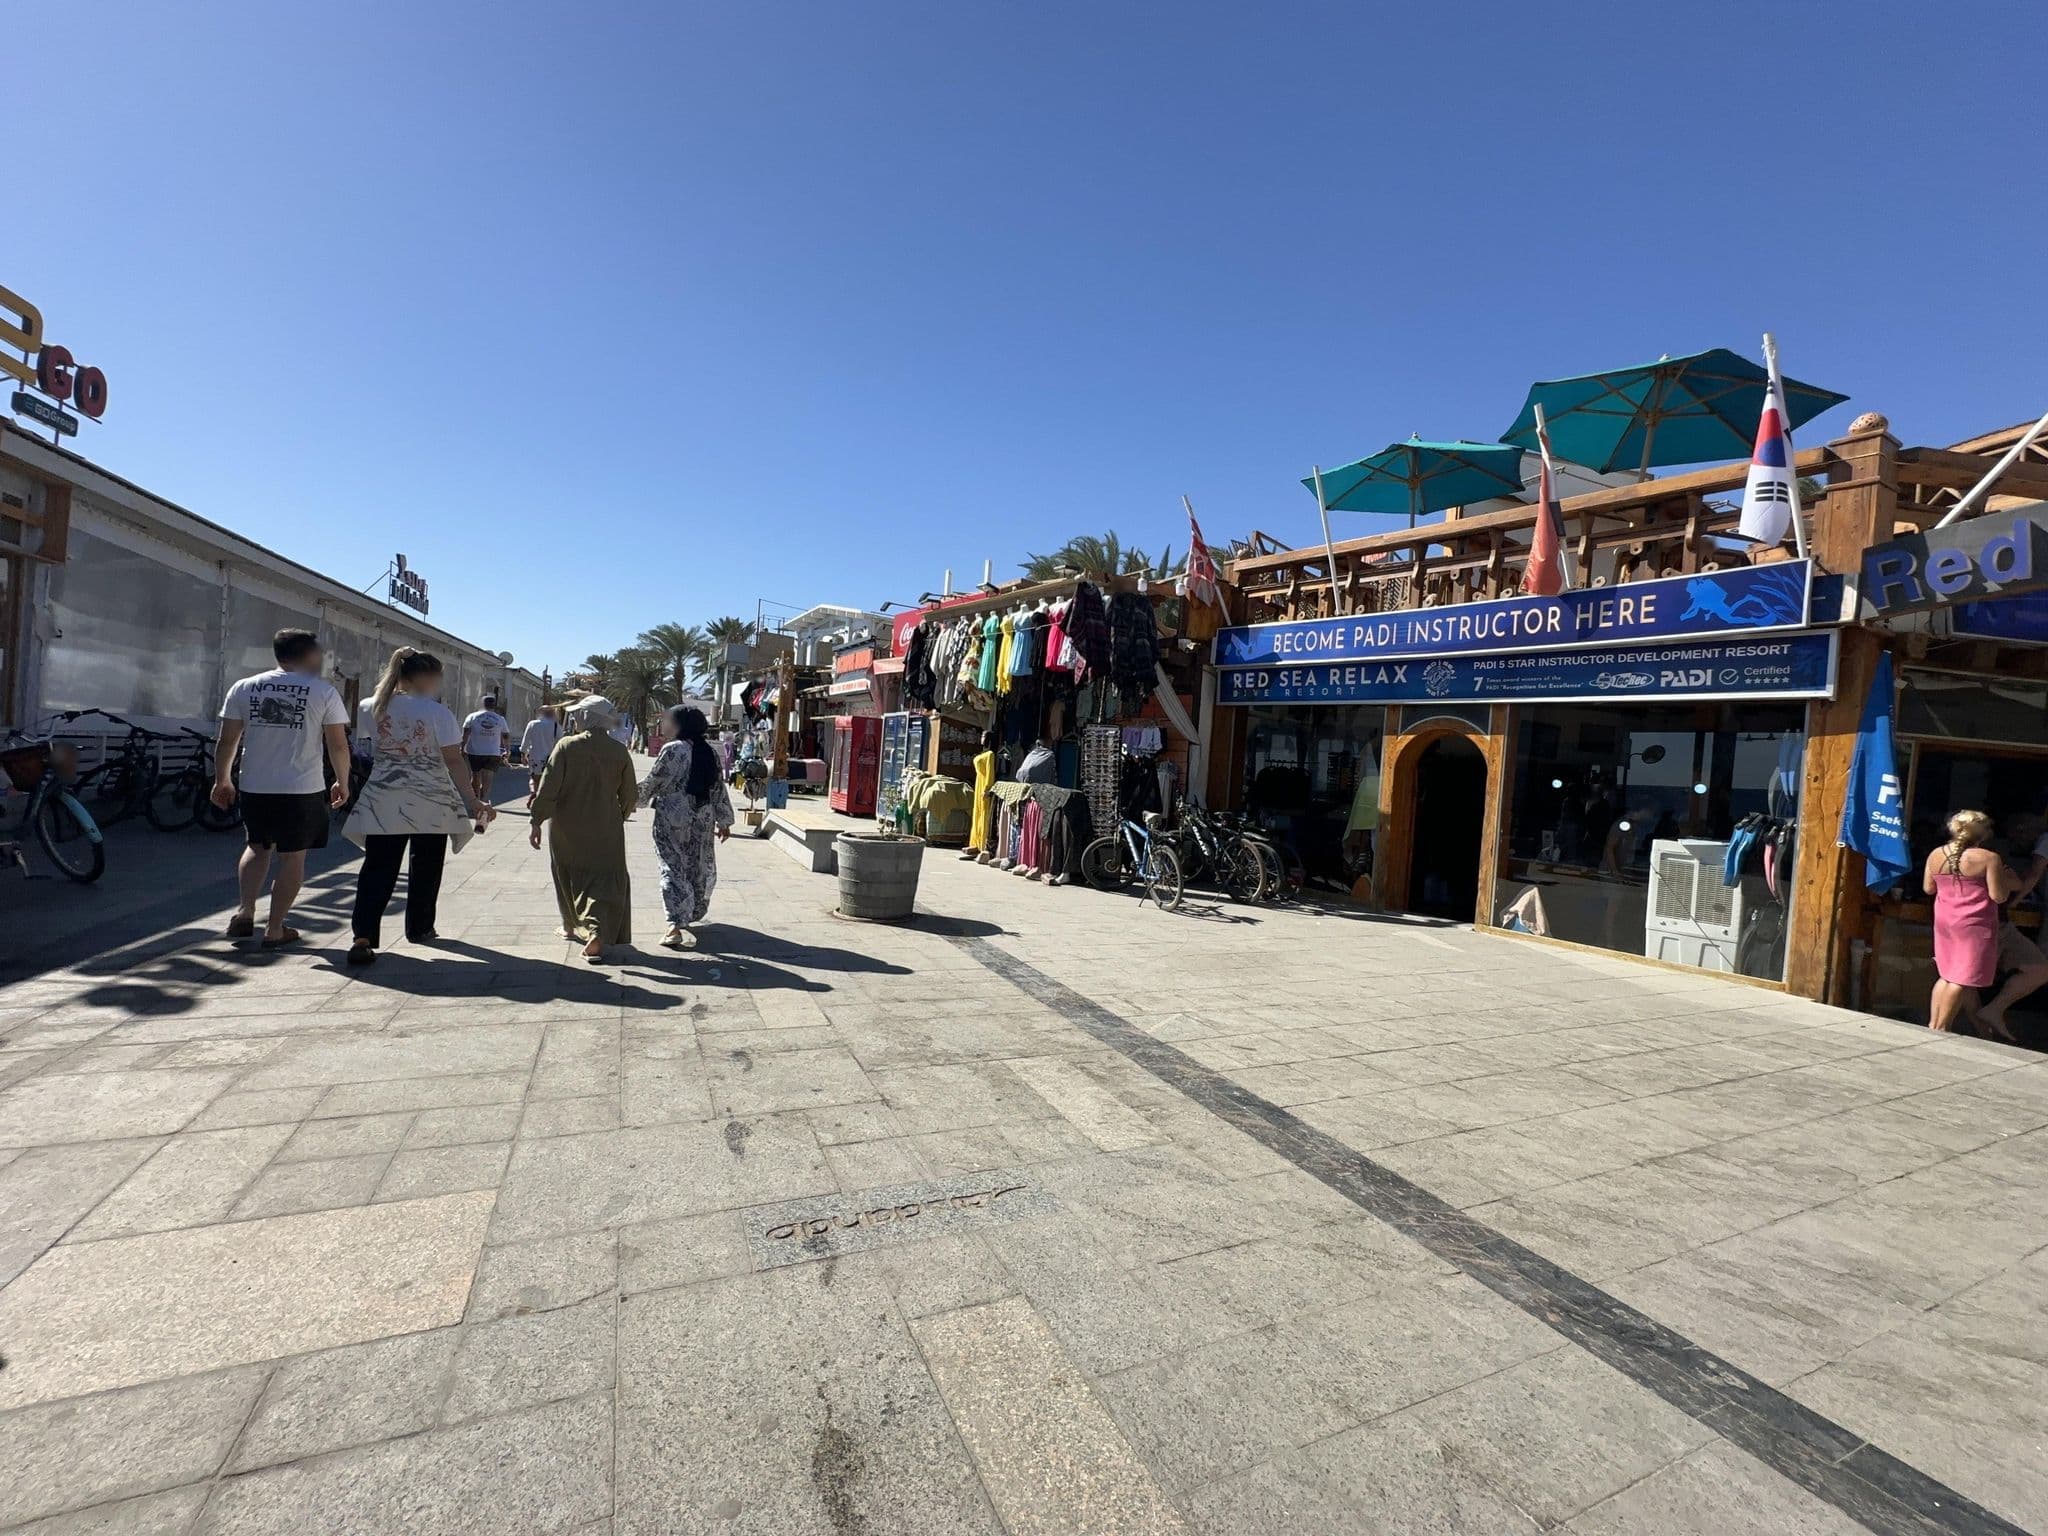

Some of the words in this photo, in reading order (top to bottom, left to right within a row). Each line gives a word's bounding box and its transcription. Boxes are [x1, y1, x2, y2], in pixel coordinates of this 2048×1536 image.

[1865, 518, 2031, 610] Red
[1273, 628, 1345, 654] BECOME
[1353, 623, 1397, 648] PADI
[1407, 606, 1561, 644] INSTRUCTOR
[1575, 594, 1656, 630] HERE
[1473, 661, 1497, 670] PADI
[1499, 660, 1505, 668] 5
[1507, 659, 1536, 668] STAR
[1538, 653, 1614, 667] INSTRUCTOR
[1618, 648, 1722, 663] DEVELOPMENT
[1725, 644, 1791, 656] RESORT
[1233, 670, 1269, 688] RED
[1279, 668, 1317, 687] SEA
[1329, 665, 1408, 685] RELAX
[1660, 669, 1713, 687] PADI
[1744, 665, 1791, 676] Certified
[1232, 689, 1272, 697] DIVE
[1284, 687, 1356, 697] RESORT
[1473, 677, 1483, 691] 7
[251, 683, 310, 696] NORTH
[290, 697, 306, 729] FACE
[1871, 811, 1902, 826] Seek
[1869, 823, 1898, 839] Save
